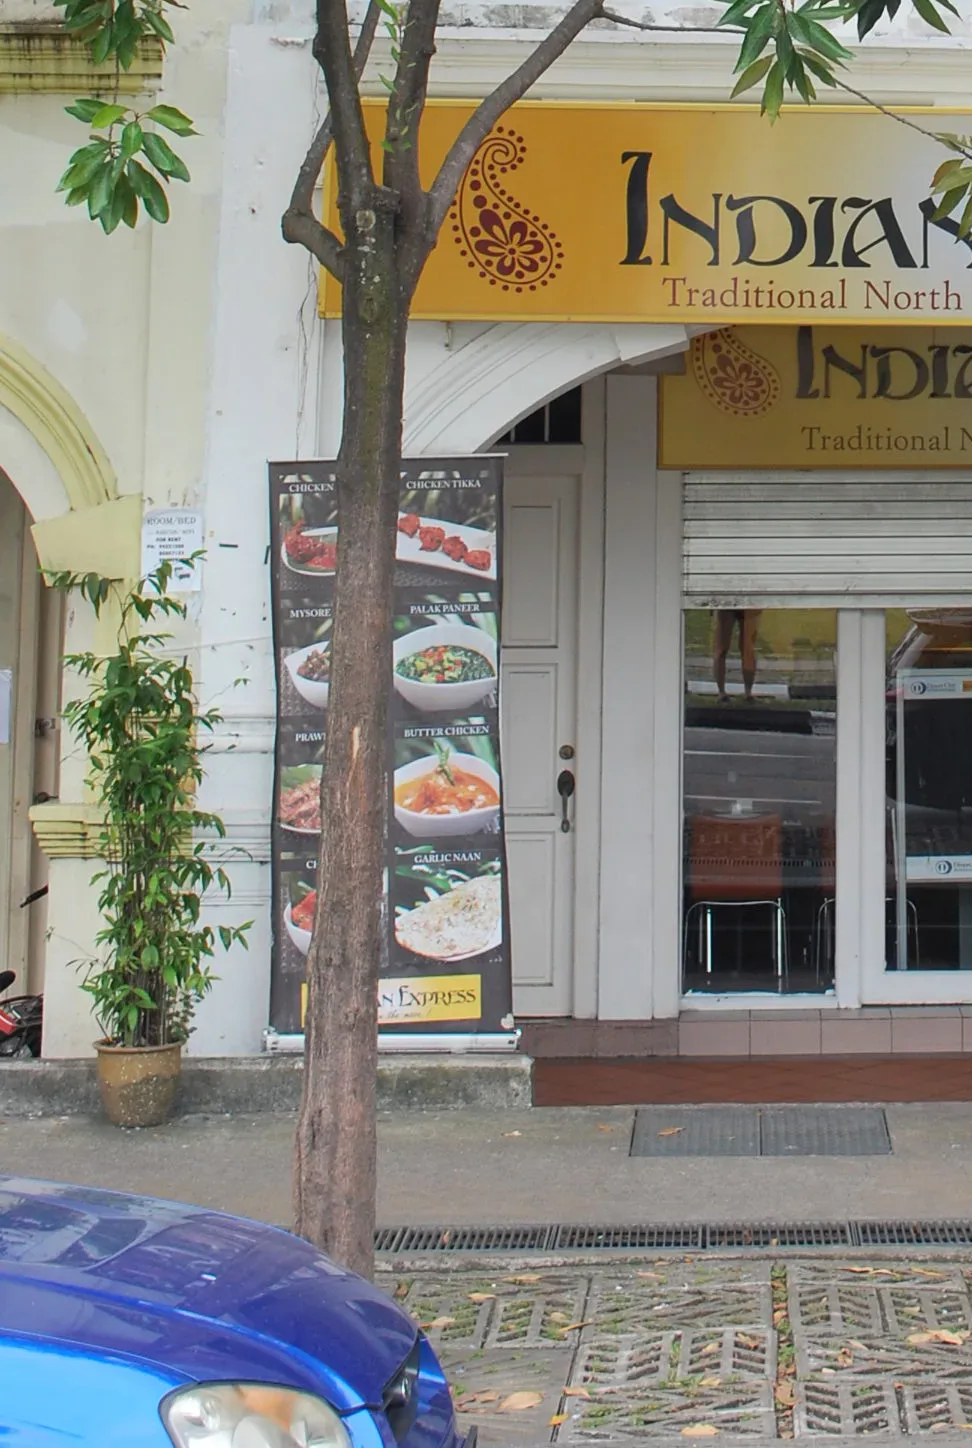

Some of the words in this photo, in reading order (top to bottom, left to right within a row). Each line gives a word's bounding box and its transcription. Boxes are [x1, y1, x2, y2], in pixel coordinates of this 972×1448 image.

[662, 277, 847, 310] Traditional
[864, 279, 962, 311] North
[800, 425, 951, 452] Traditional
[289, 483, 334, 493] CHICKEN
[406, 480, 451, 490] CHICKEN
[452, 479, 481, 489] TIKKA
[290, 608, 331, 618] MYSORE
[410, 604, 441, 614] PALAK
[442, 603, 480, 613] PANEER
[404, 727, 444, 738] BUTTER
[445, 725, 490, 736] CHICKEN
[414, 853, 451, 864] GARLIC
[452, 852, 481, 862] NAAN
[398, 985, 477, 1007] EXPRESS
